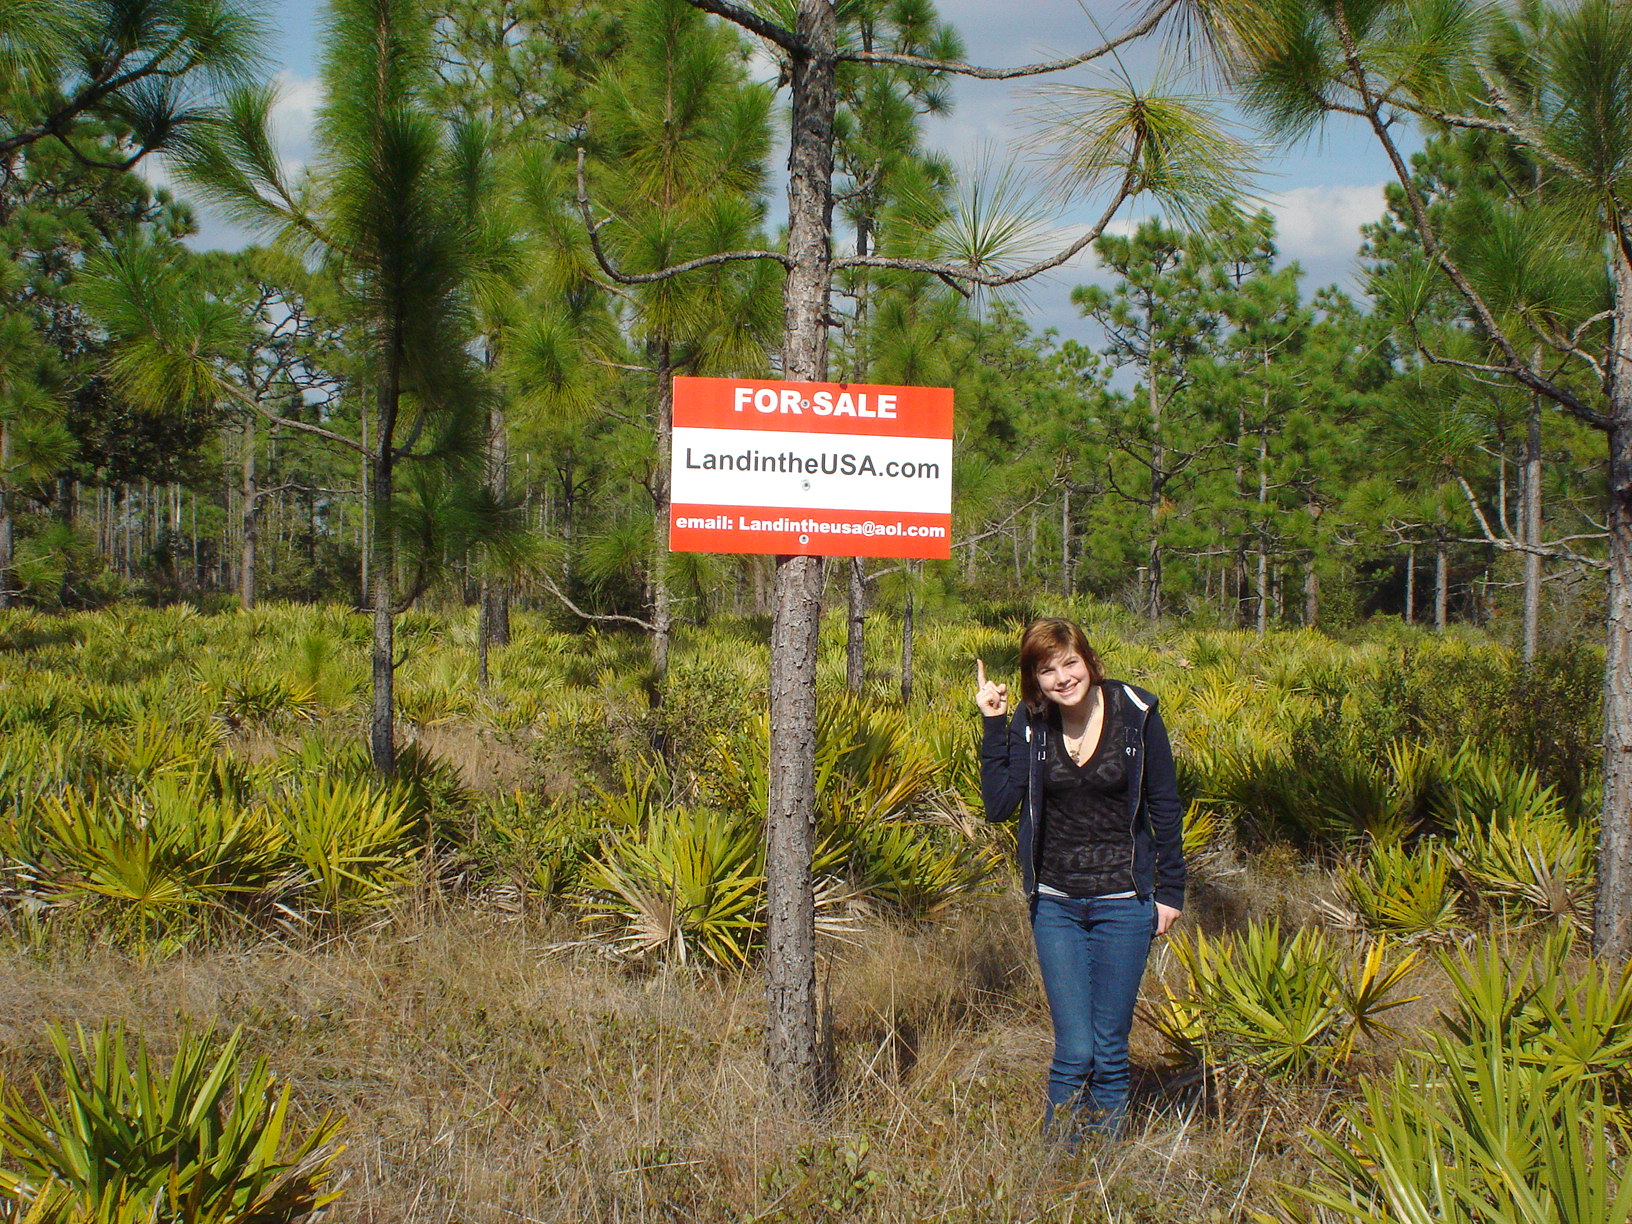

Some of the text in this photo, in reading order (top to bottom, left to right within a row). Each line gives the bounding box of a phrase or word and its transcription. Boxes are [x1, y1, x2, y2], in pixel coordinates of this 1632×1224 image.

[734, 387, 898, 419] FOR SALE
[685, 447, 941, 479] LandintheUSA.com
[675, 515, 946, 538] email: Landintheusa@aol.com
